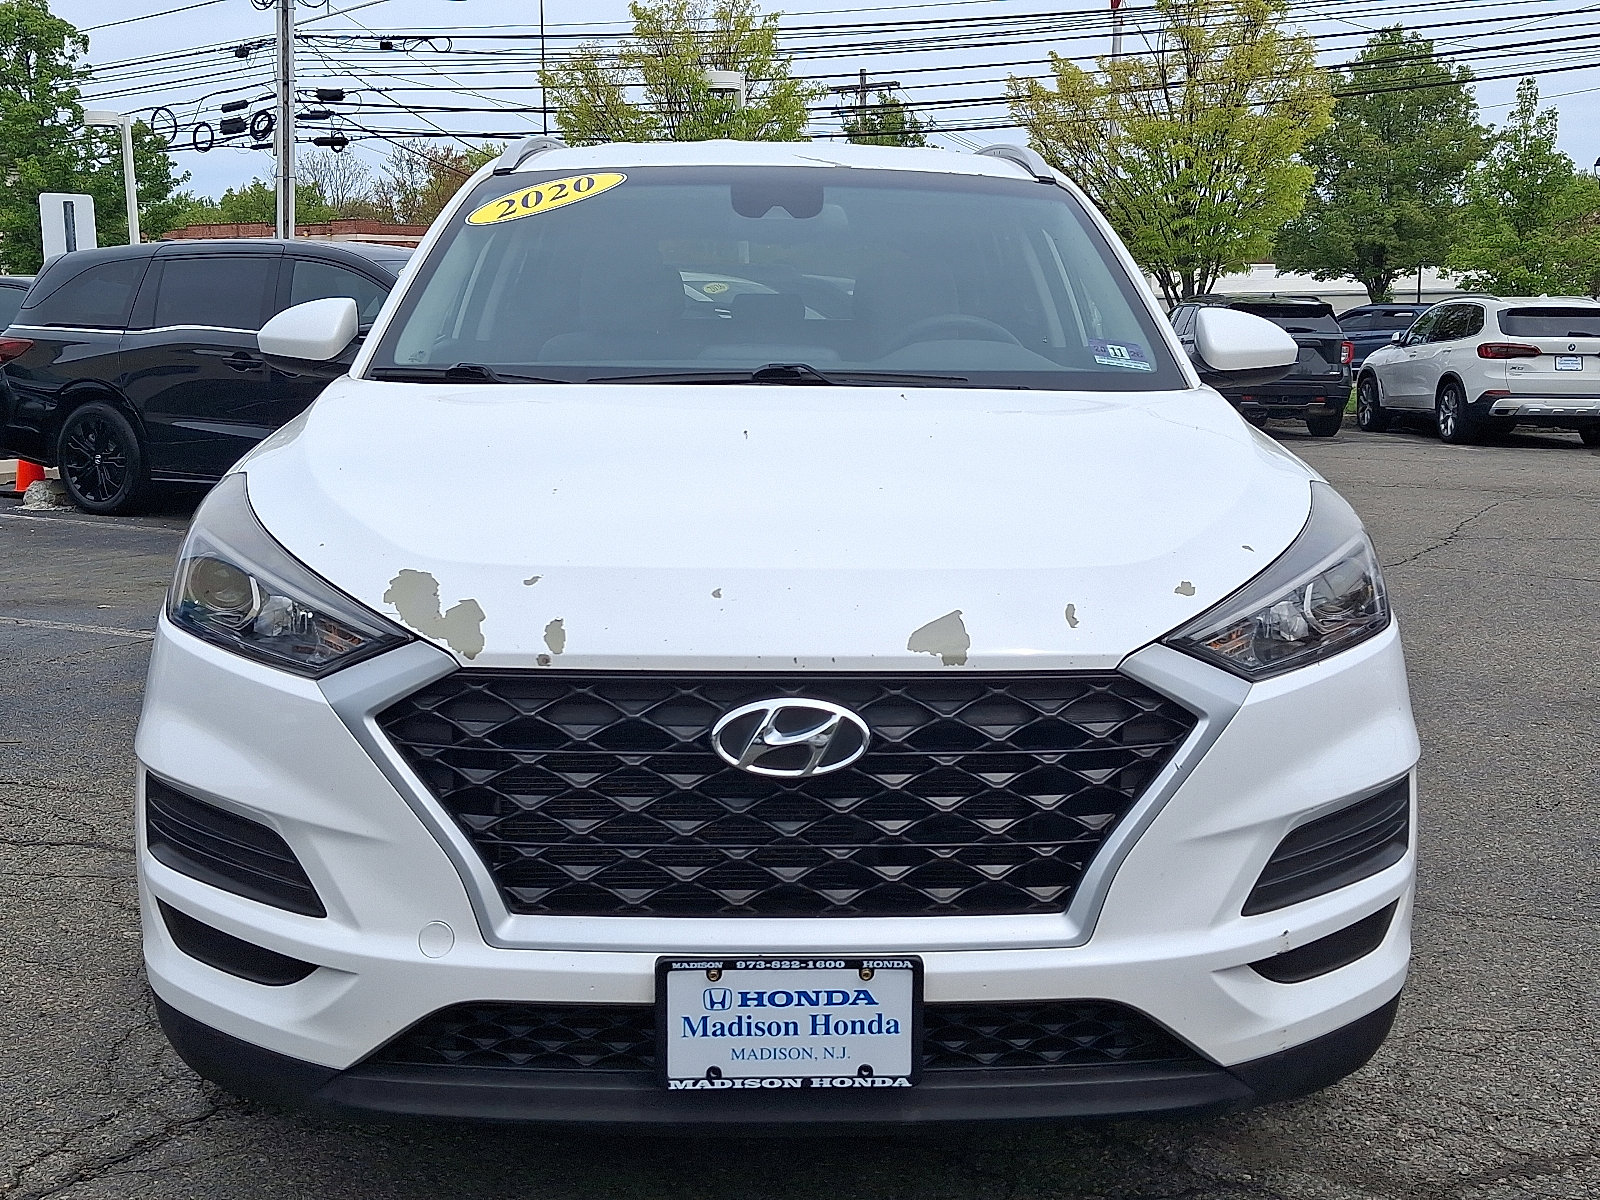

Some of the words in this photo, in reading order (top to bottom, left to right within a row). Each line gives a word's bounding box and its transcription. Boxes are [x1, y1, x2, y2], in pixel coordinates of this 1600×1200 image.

[496, 176, 595, 219] 2020
[1110, 347, 1125, 357] 11
[862, 960, 913, 968] HONDA
[738, 990, 879, 1007] HONDA
[681, 1015, 799, 1037] Madison
[809, 1013, 900, 1036] Honda
[731, 1047, 818, 1061] MADISON,
[823, 1046, 851, 1060] N.J.
[668, 1079, 802, 1089] MADISON
[810, 1078, 912, 1087] HONDA
